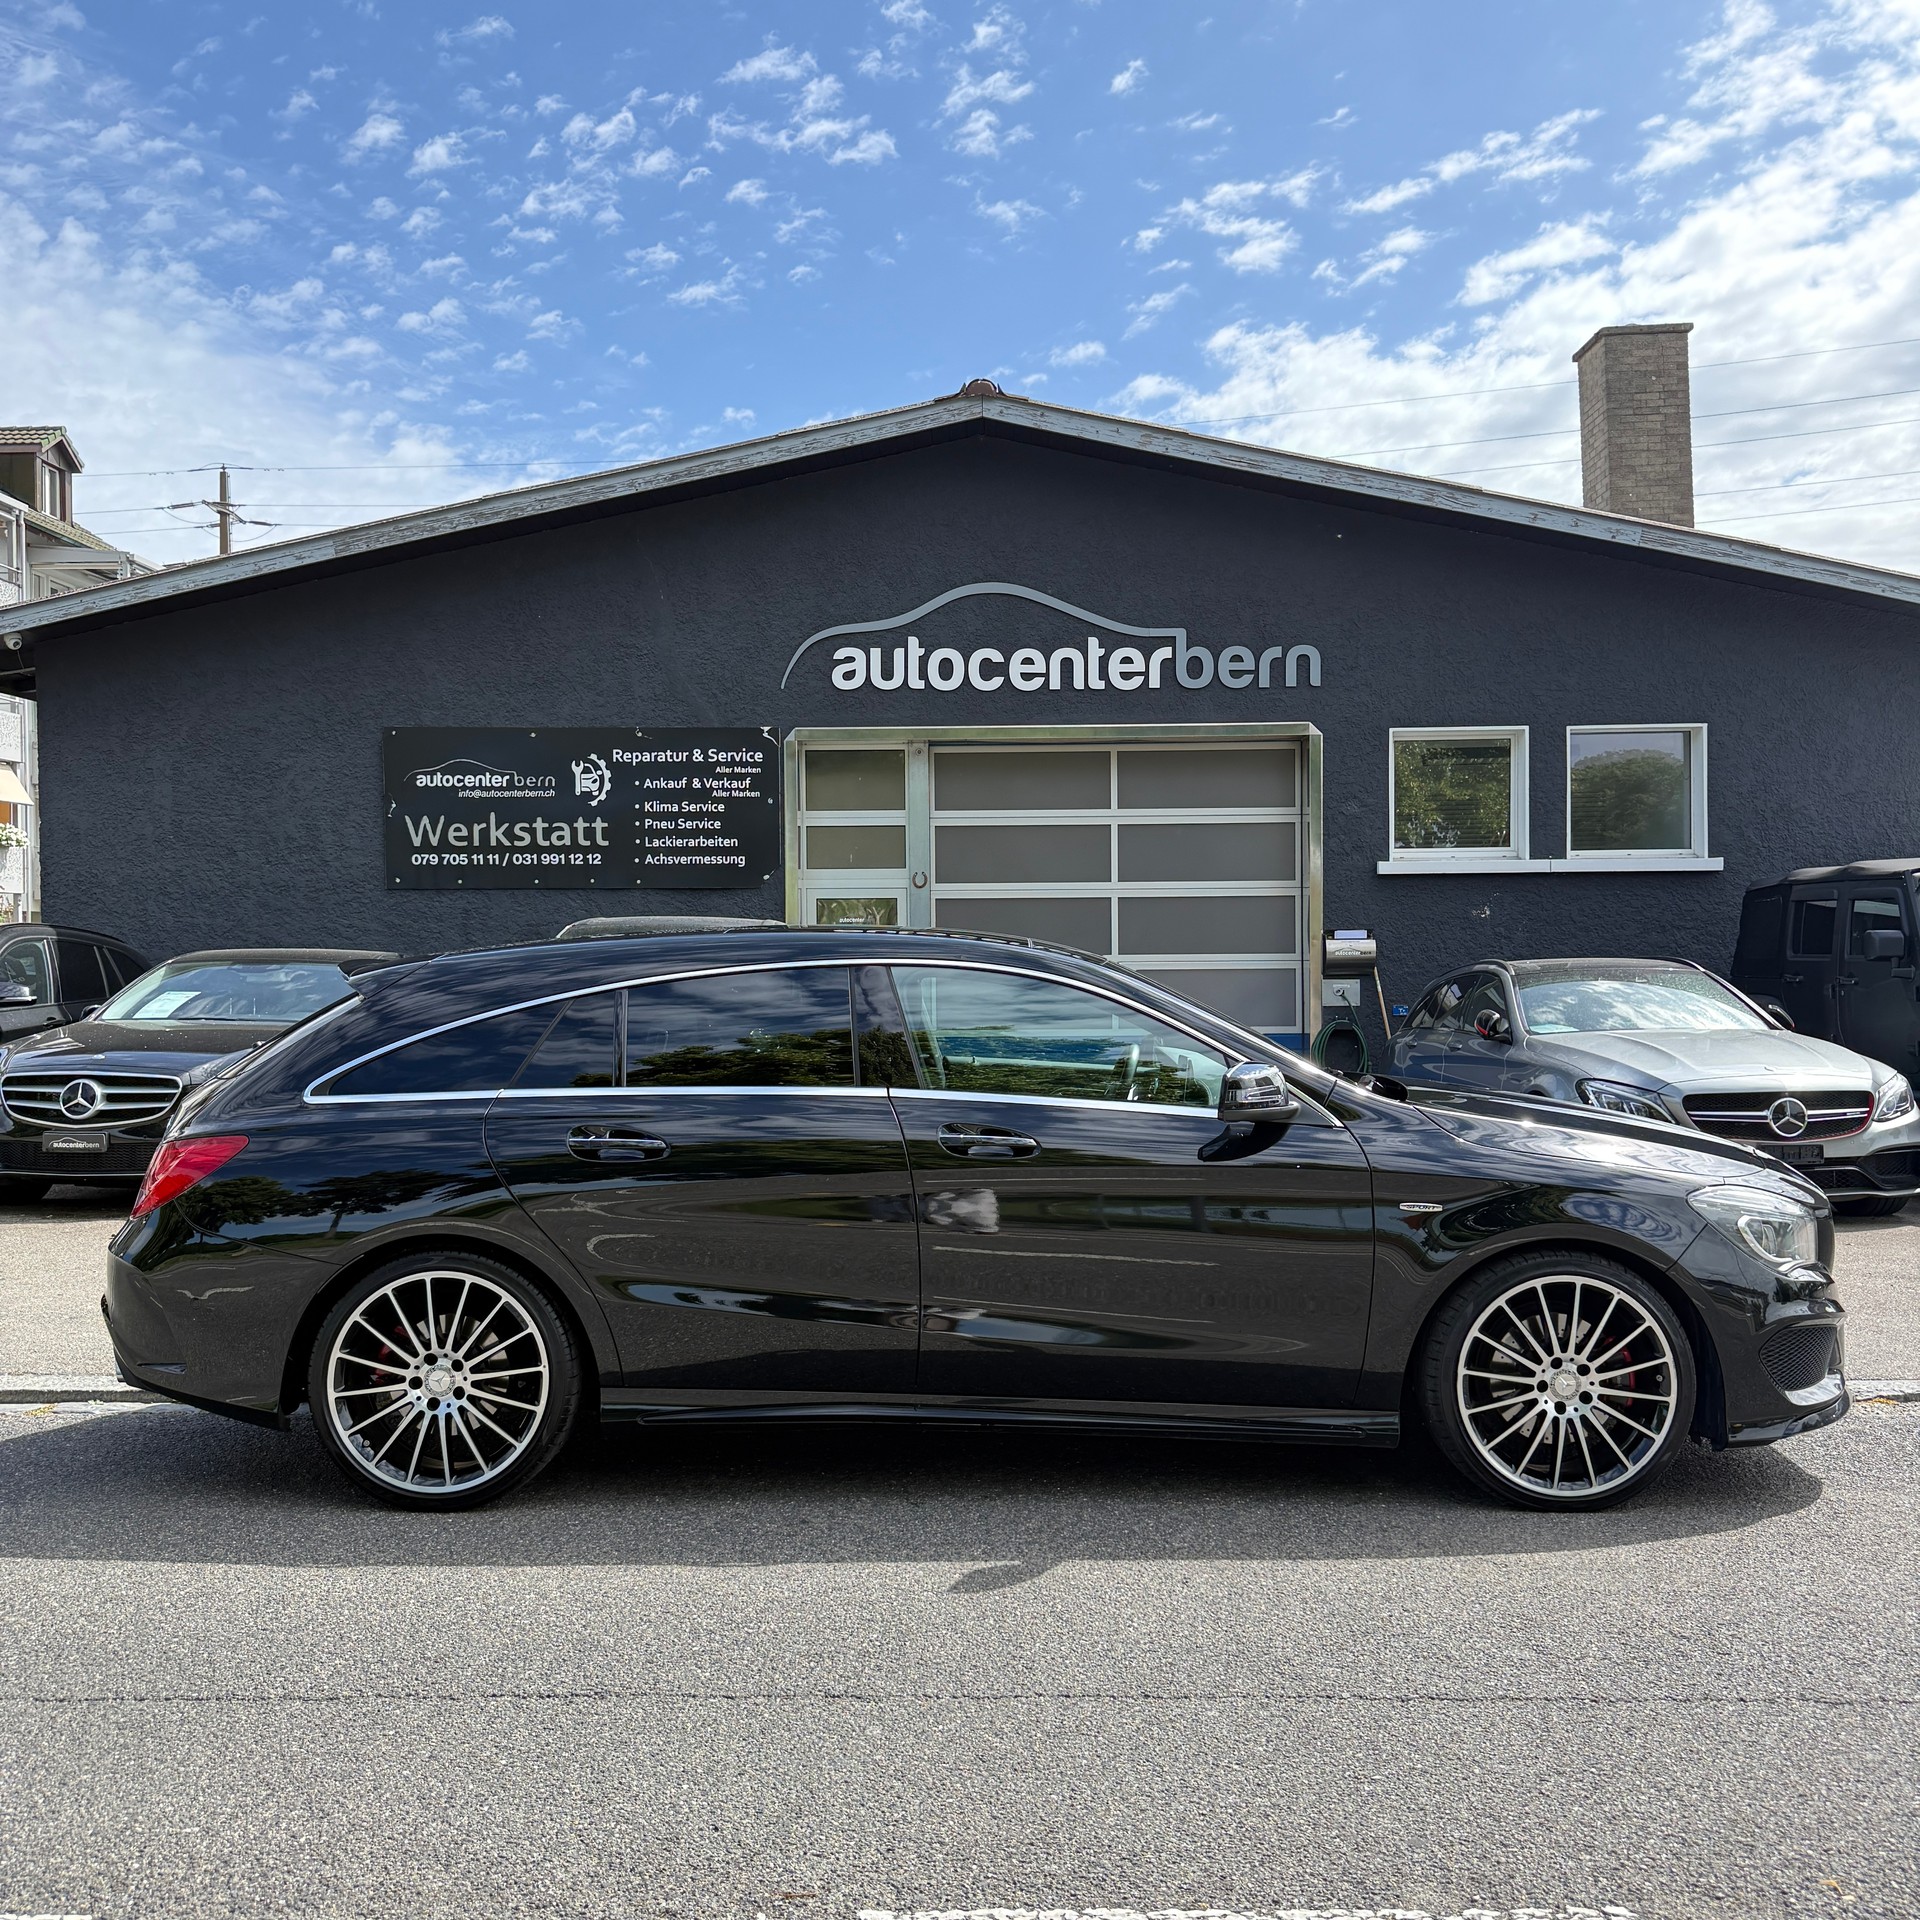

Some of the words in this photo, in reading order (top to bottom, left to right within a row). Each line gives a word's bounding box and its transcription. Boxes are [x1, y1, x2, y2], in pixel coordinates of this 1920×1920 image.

[612, 749, 689, 766] Reparatur
[692, 749, 704, 763] &
[707, 748, 764, 763] Service
[715, 766, 733, 774] Aller
[734, 766, 762, 774] Marken
[416, 772, 510, 787] autocenter
[643, 778, 688, 789] Ankauf
[692, 779, 702, 789] &
[703, 778, 752, 789] Verkauf
[458, 789, 556, 799] info@autocenterbern.ch
[711, 790, 731, 798] Aller
[731, 790, 761, 798] Marken
[644, 801, 679, 813] Klima
[681, 801, 726, 813] Service
[404, 811, 610, 847] Werkstatt
[644, 818, 675, 830] Pneu
[677, 818, 722, 830] Service
[645, 836, 739, 848] Lackierarbeiten
[411, 853, 439, 866] 079
[441, 853, 469, 866] 705
[512, 853, 538, 866] 031
[541, 853, 565, 866] 991
[568, 853, 584, 866] 12
[586, 853, 602, 866] 12
[644, 853, 746, 868] Achsvermessung
